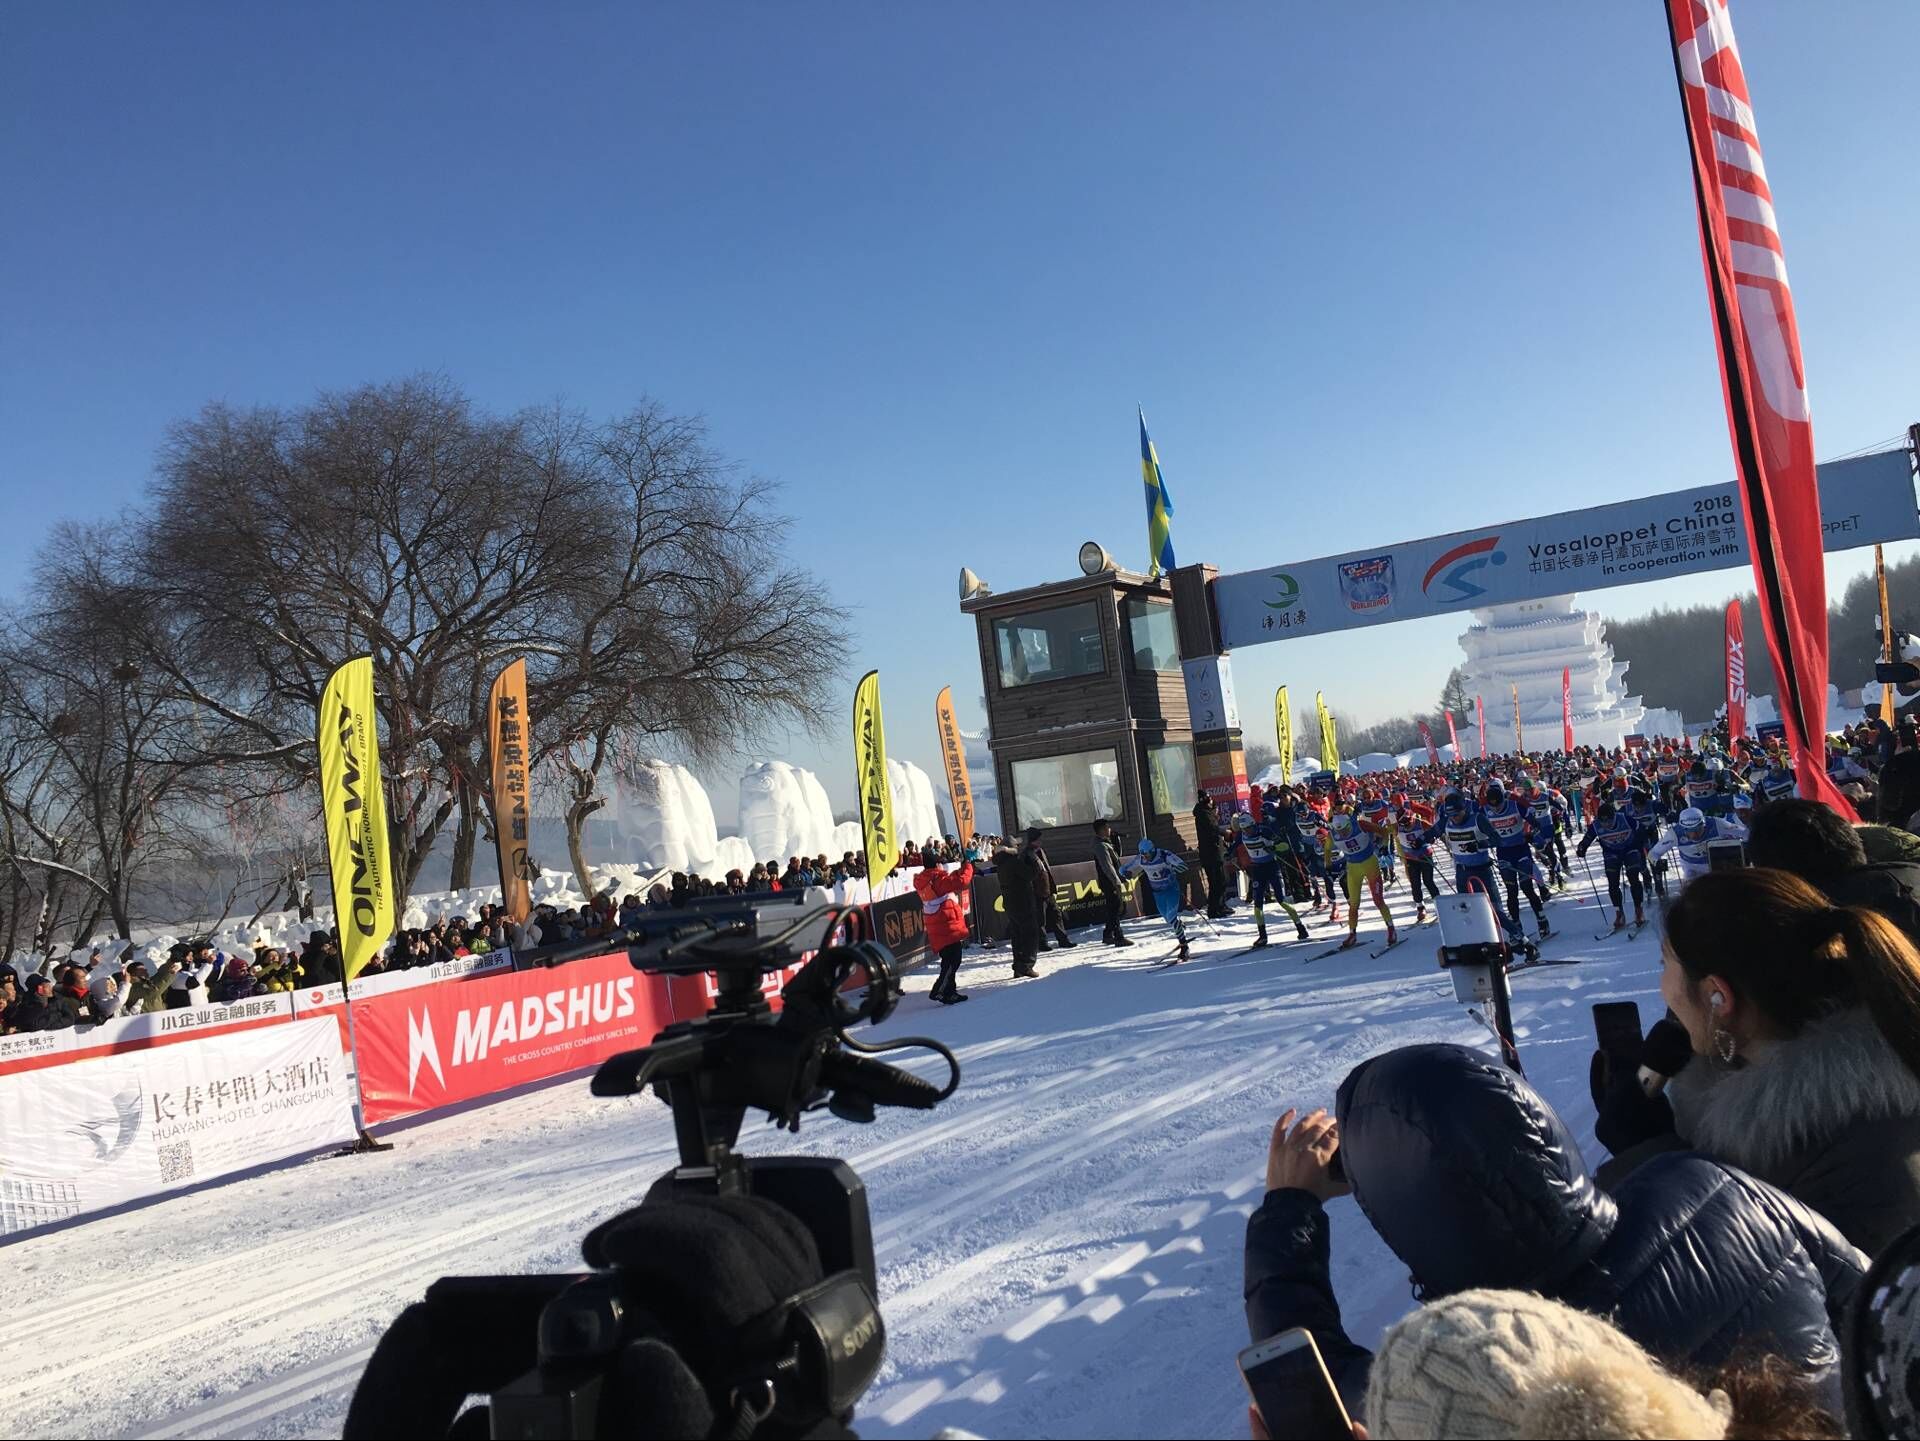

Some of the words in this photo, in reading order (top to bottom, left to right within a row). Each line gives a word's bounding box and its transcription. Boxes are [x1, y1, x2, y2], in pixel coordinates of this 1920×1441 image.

[1692, 495, 1733, 514] 2018
[1527, 522, 1657, 558] Vasaloppet
[1665, 510, 1736, 534] China
[1528, 526, 1737, 575] 中国长春净月潭瓦萨国际滑雪节
[1602, 564, 1615, 576] in
[1618, 549, 1706, 573] cooperation
[1709, 543, 1740, 558] with
[355, 713, 366, 749] BRAND
[365, 836, 383, 890] AUTHENTIC
[430, 952, 504, 979] 小企业金融服务
[160, 999, 277, 1031] 小企业金融服务
[451, 976, 635, 1067] MADSHUS
[503, 1057, 517, 1066] THE
[517, 1051, 541, 1062] CROSS
[540, 1042, 574, 1057] COUNTRY
[574, 1034, 606, 1048] COMPANY
[605, 1031, 624, 1040] SINCE
[151, 1115, 215, 1142] HUAYANG
[217, 1106, 259, 1127] HOTEL
[261, 1087, 335, 1114] CHANGCHUN
[843, 1313, 877, 1357] SONY
